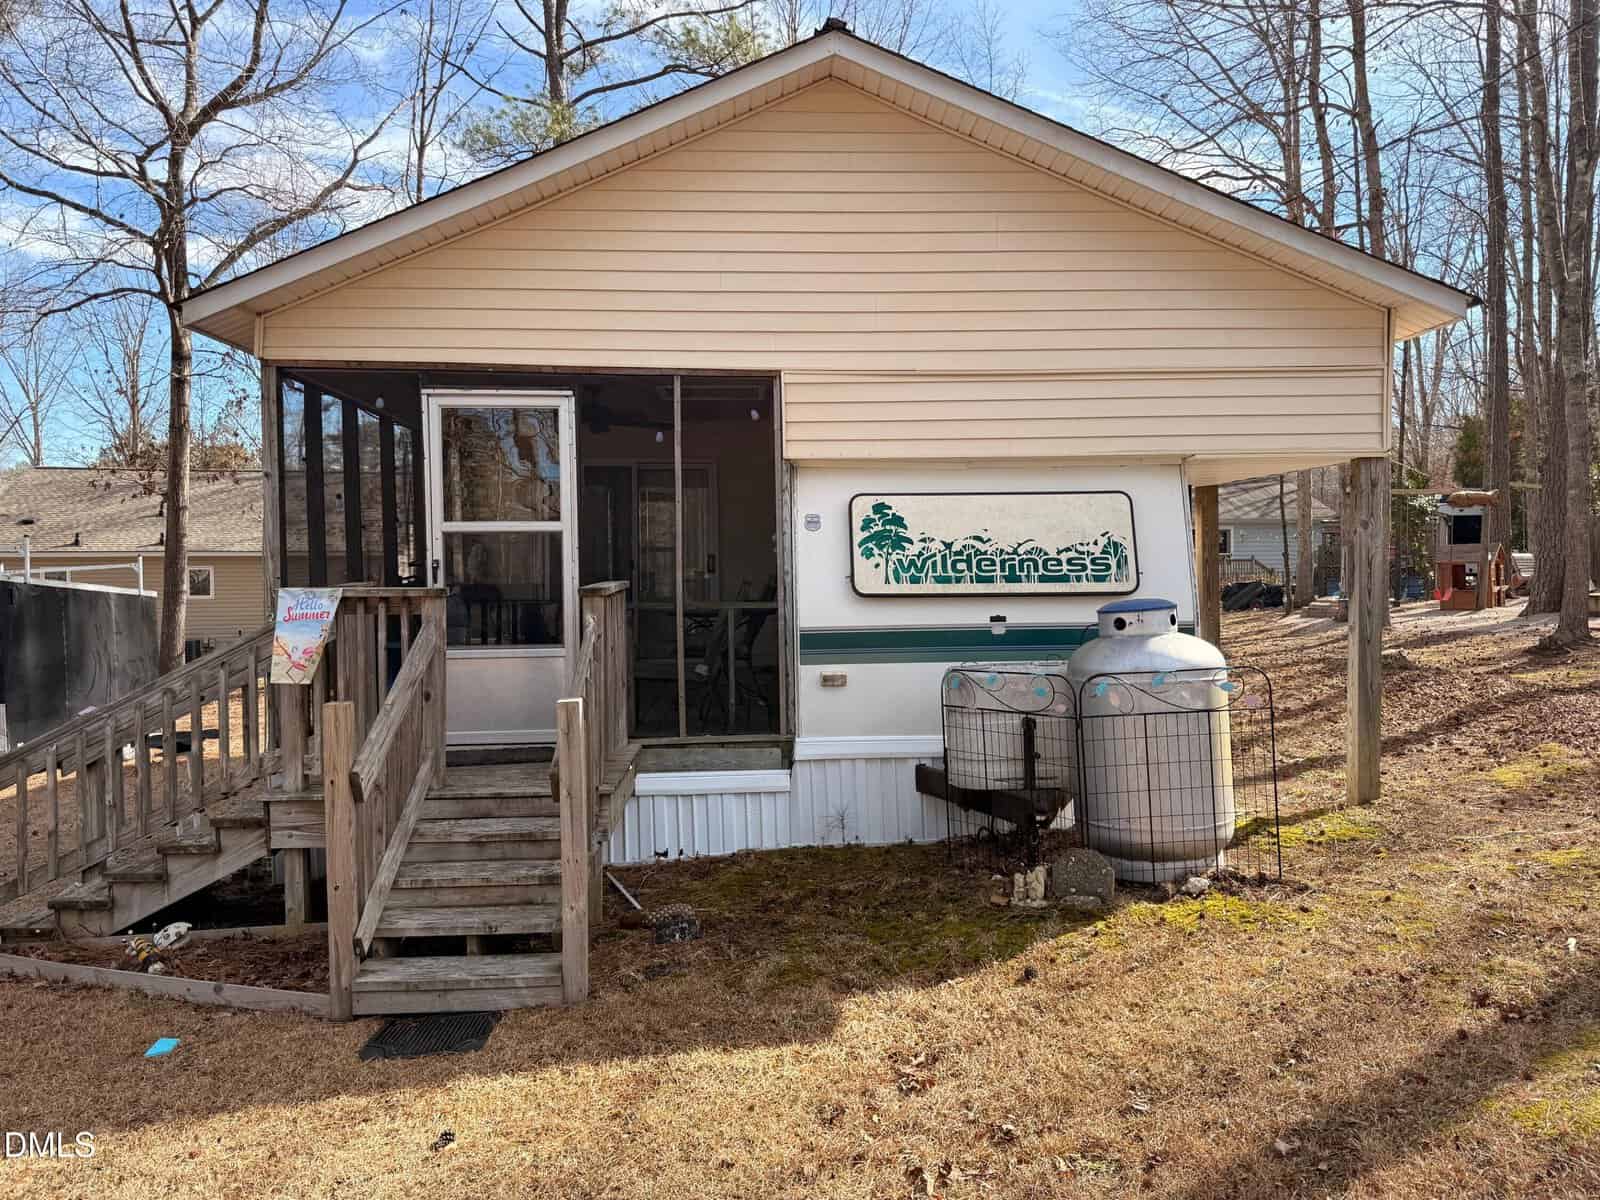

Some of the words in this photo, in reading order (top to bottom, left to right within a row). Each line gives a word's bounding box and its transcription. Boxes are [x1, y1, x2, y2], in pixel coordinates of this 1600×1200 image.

[897, 553, 1113, 575] wilderness
[295, 596, 324, 610] Hello
[283, 606, 331, 623] Summer
